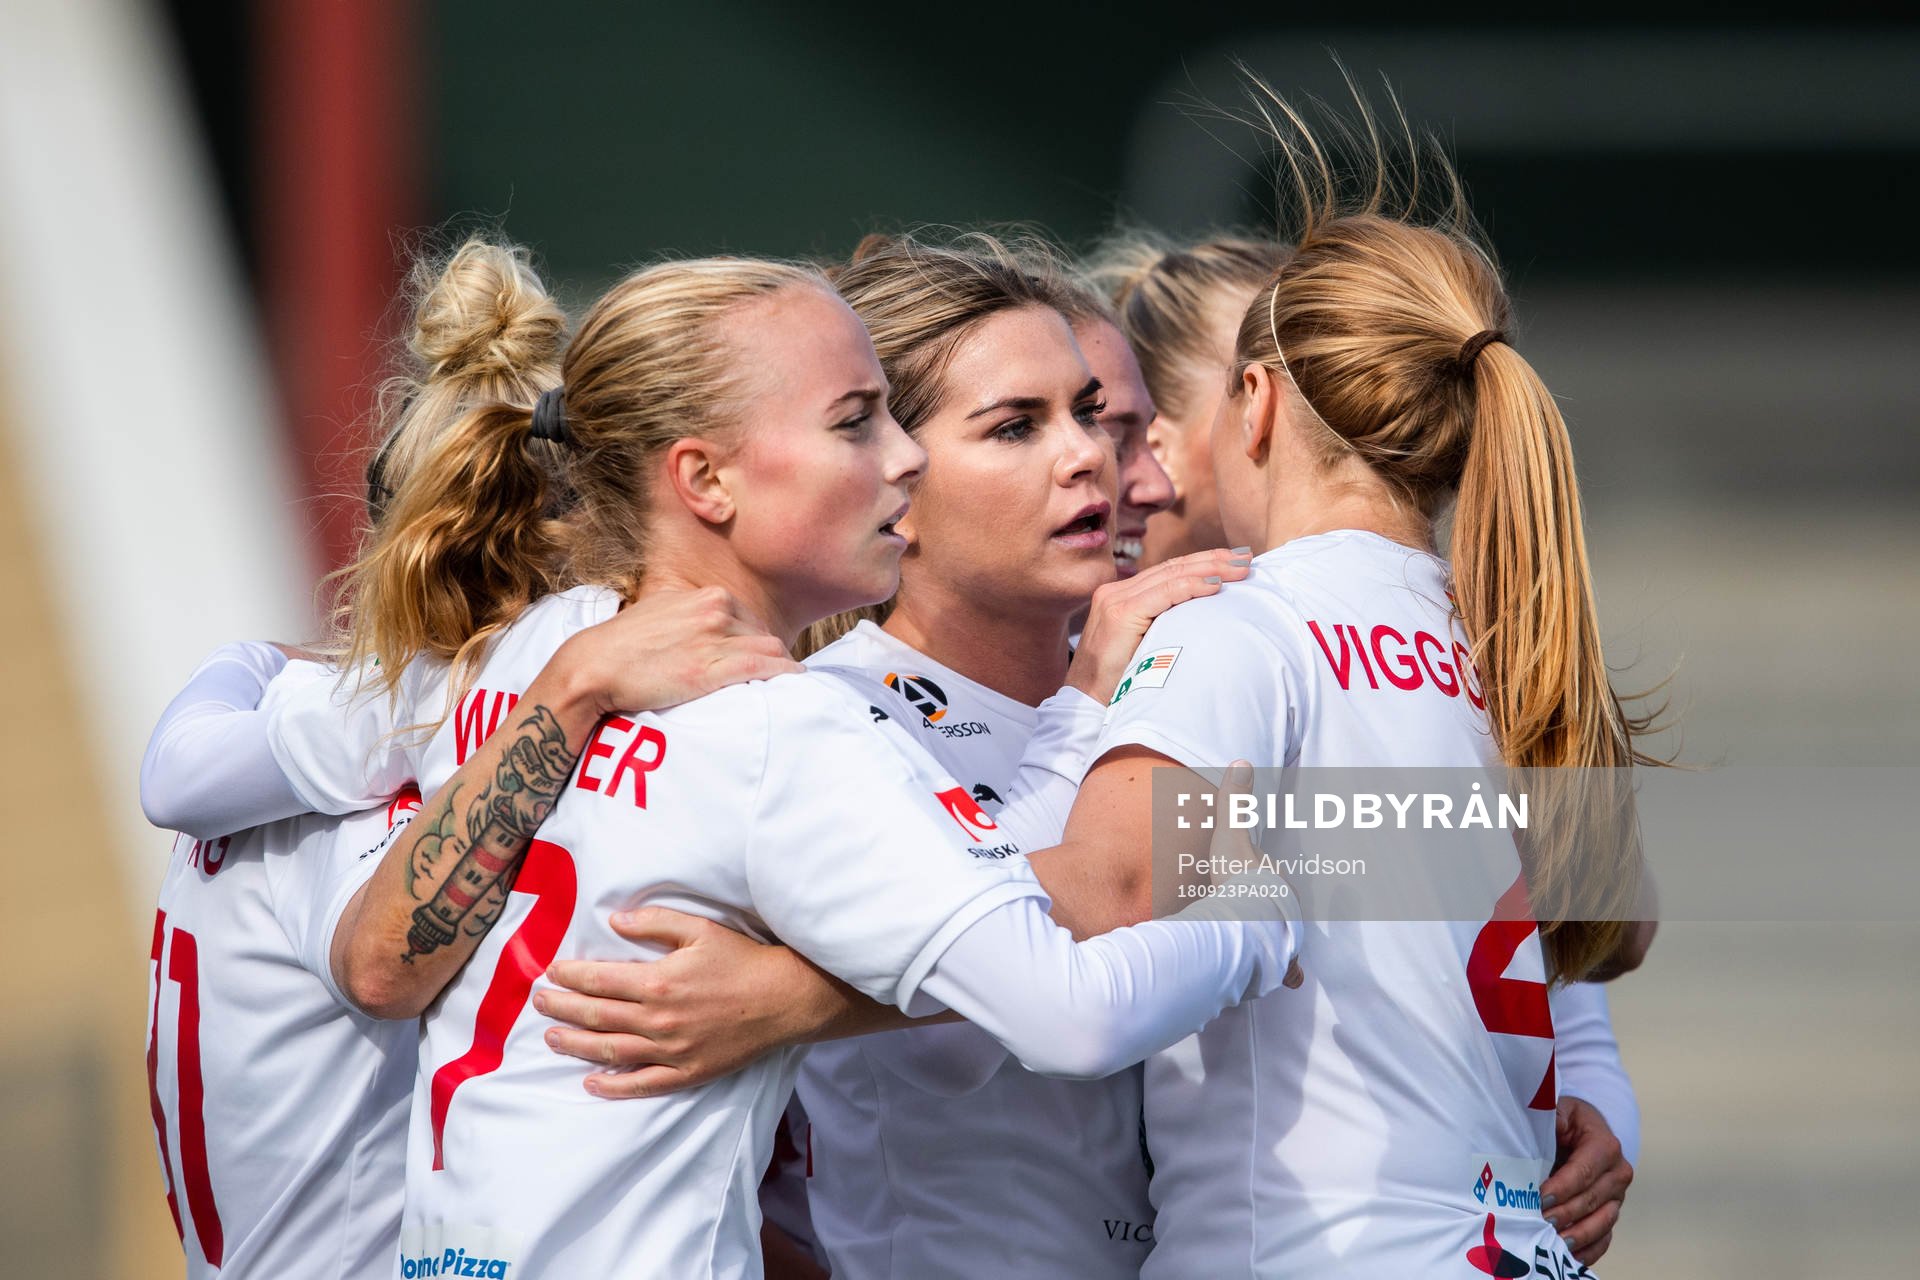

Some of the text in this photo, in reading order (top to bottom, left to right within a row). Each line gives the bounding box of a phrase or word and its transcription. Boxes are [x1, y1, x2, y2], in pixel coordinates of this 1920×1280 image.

[431, 838, 577, 1171] 7
[1495, 1181, 1540, 1210] Domin
[1103, 1220, 1153, 1242] VIC
[441, 1248, 508, 1280] Pizza
